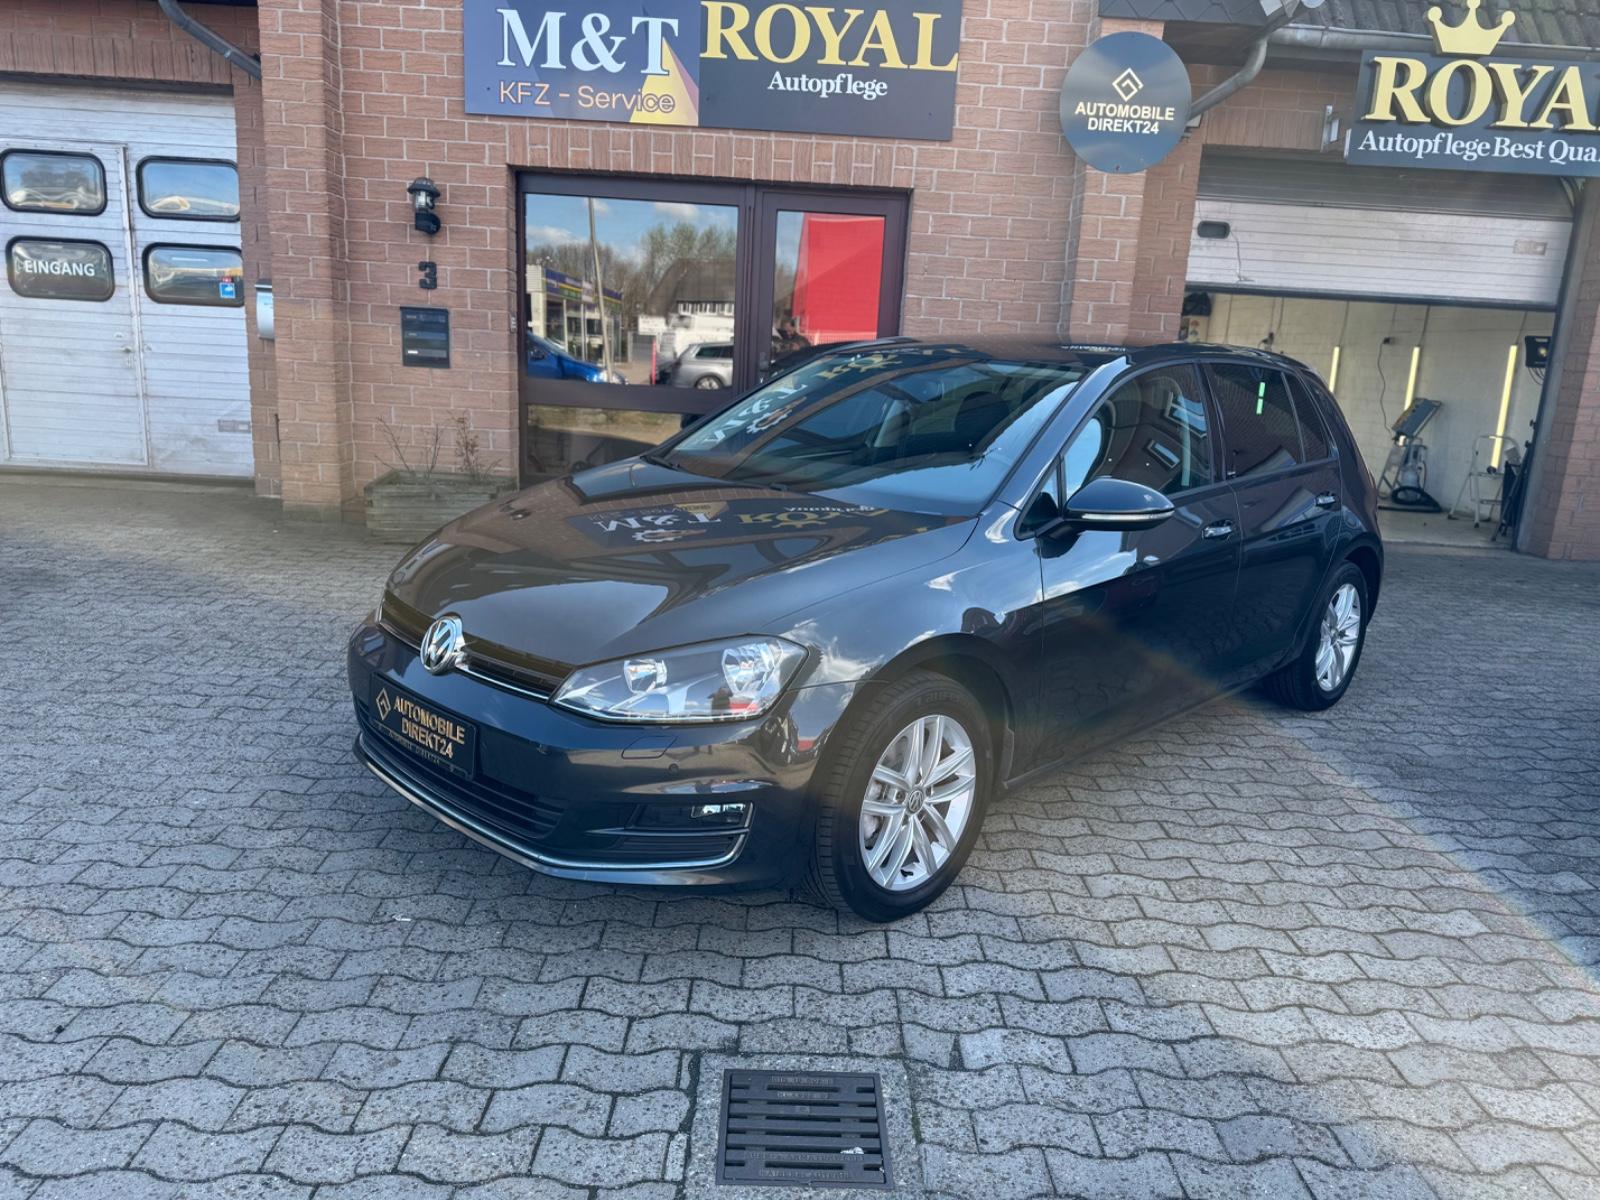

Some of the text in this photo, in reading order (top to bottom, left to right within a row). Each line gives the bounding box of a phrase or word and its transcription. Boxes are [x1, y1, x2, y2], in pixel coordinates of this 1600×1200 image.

[496, 8, 679, 76] M&T
[699, 1, 959, 72] ROYAL
[499, 81, 551, 105] KFZ
[577, 85, 677, 113] Service
[767, 70, 888, 100] Autopflege
[1360, 56, 1600, 131] ROYA
[1074, 101, 1175, 121] AUTOMOBILE
[1087, 117, 1160, 135] DIREKT24
[1358, 130, 1600, 165] Autopflege Best Qua
[24, 259, 96, 277] EINGANG
[418, 261, 438, 290] 3
[393, 695, 466, 745] AUTOMOBILE
[401, 717, 454, 759] DIREKT24
